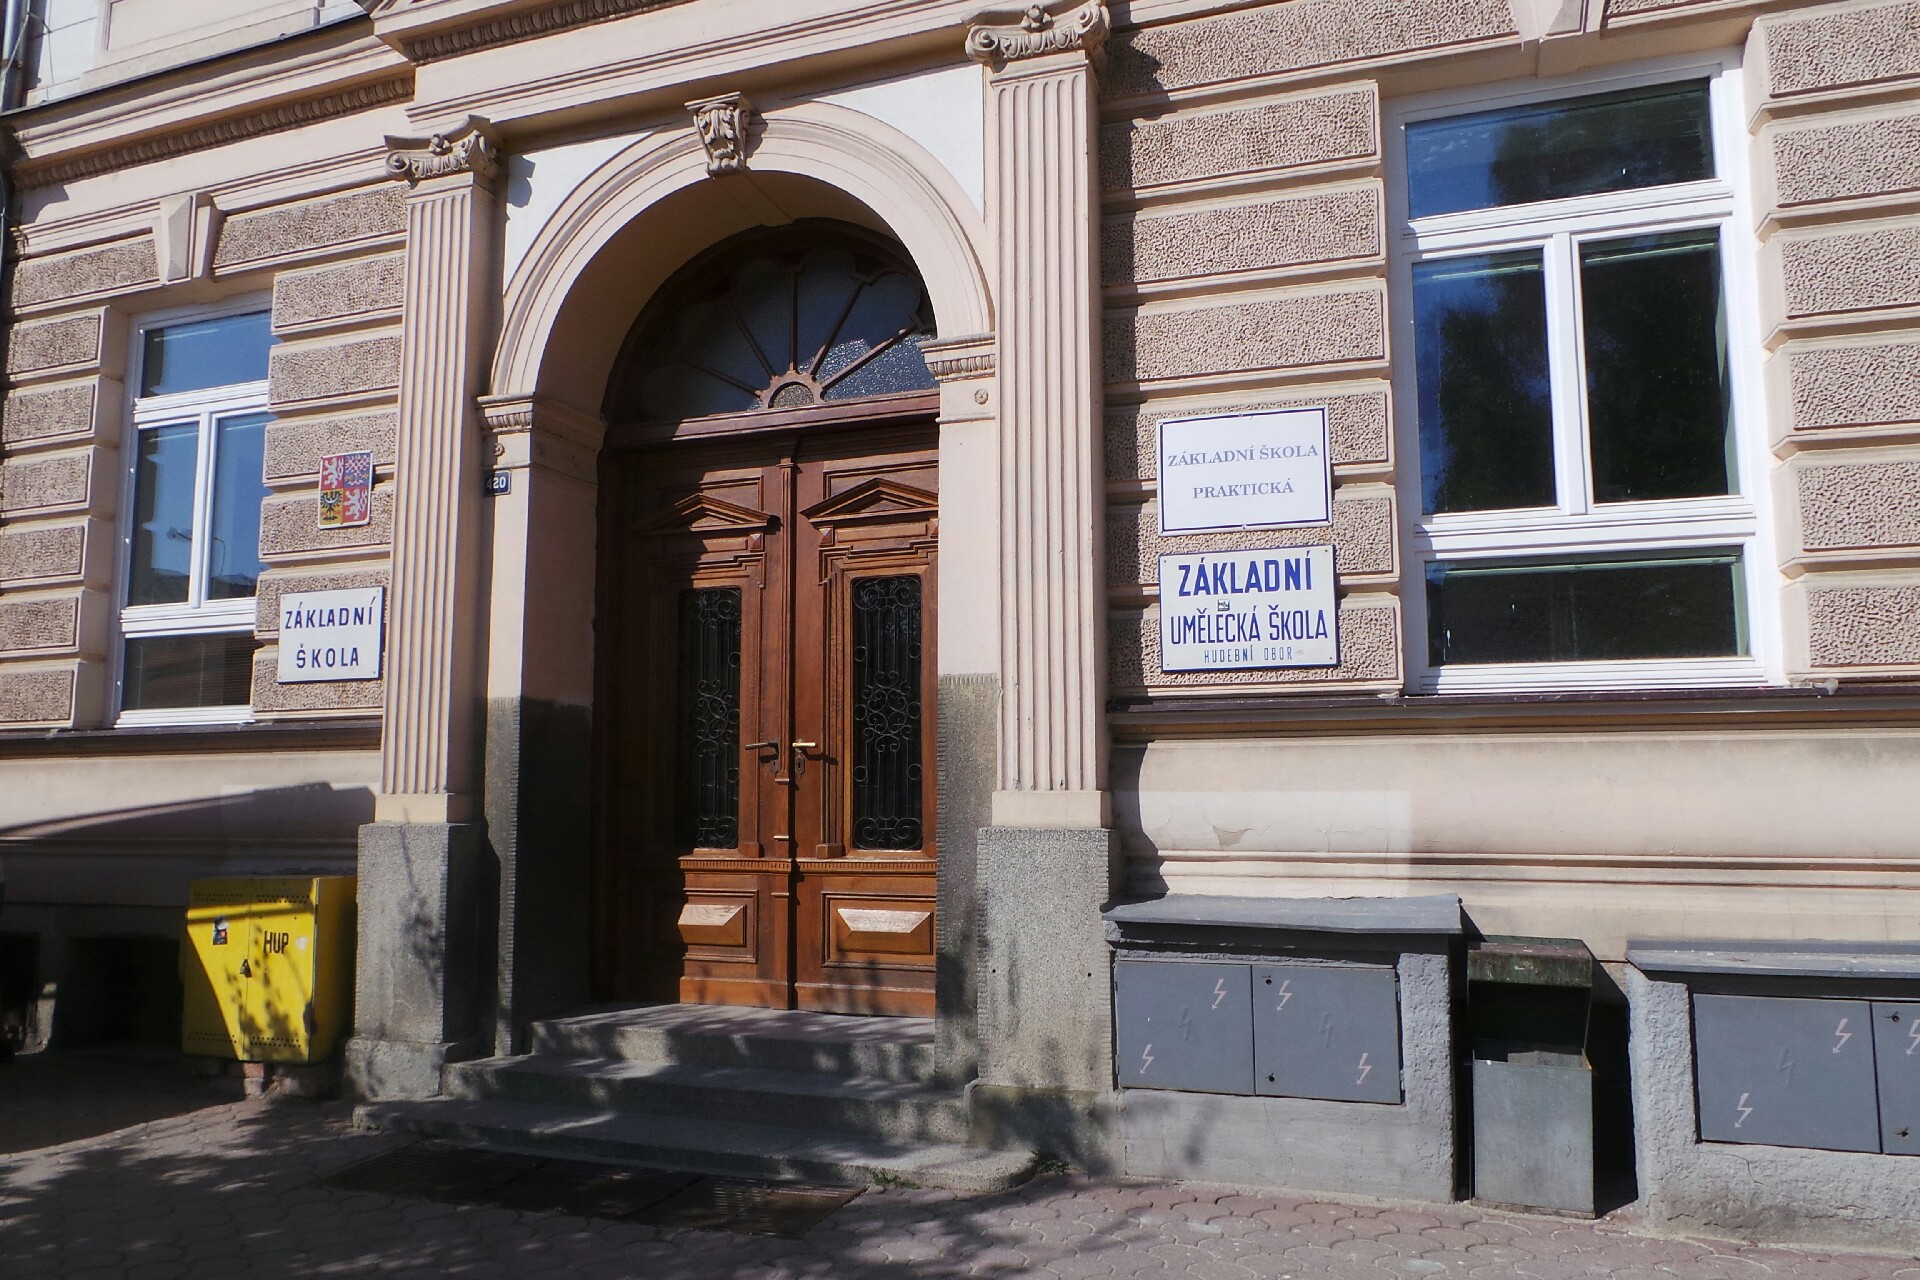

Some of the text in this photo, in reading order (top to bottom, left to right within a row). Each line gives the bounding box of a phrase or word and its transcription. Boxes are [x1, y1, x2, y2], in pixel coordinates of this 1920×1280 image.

[1168, 444, 1319, 467] ZÁKLADNÍ ŠKOLA
[486, 476, 507, 489] 420
[1193, 478, 1294, 499] PRAKTICKÁ
[1178, 551, 1312, 597] ZÁKLADNÍ
[285, 596, 377, 630] ZÁKLADNÍ
[1170, 604, 1328, 644] UMĚLECKÁ ŠKOLA
[296, 643, 359, 669] ŠKOLA
[1204, 645, 1293, 663] HUDEBNÍ OBOR
[263, 930, 289, 954] HUP
